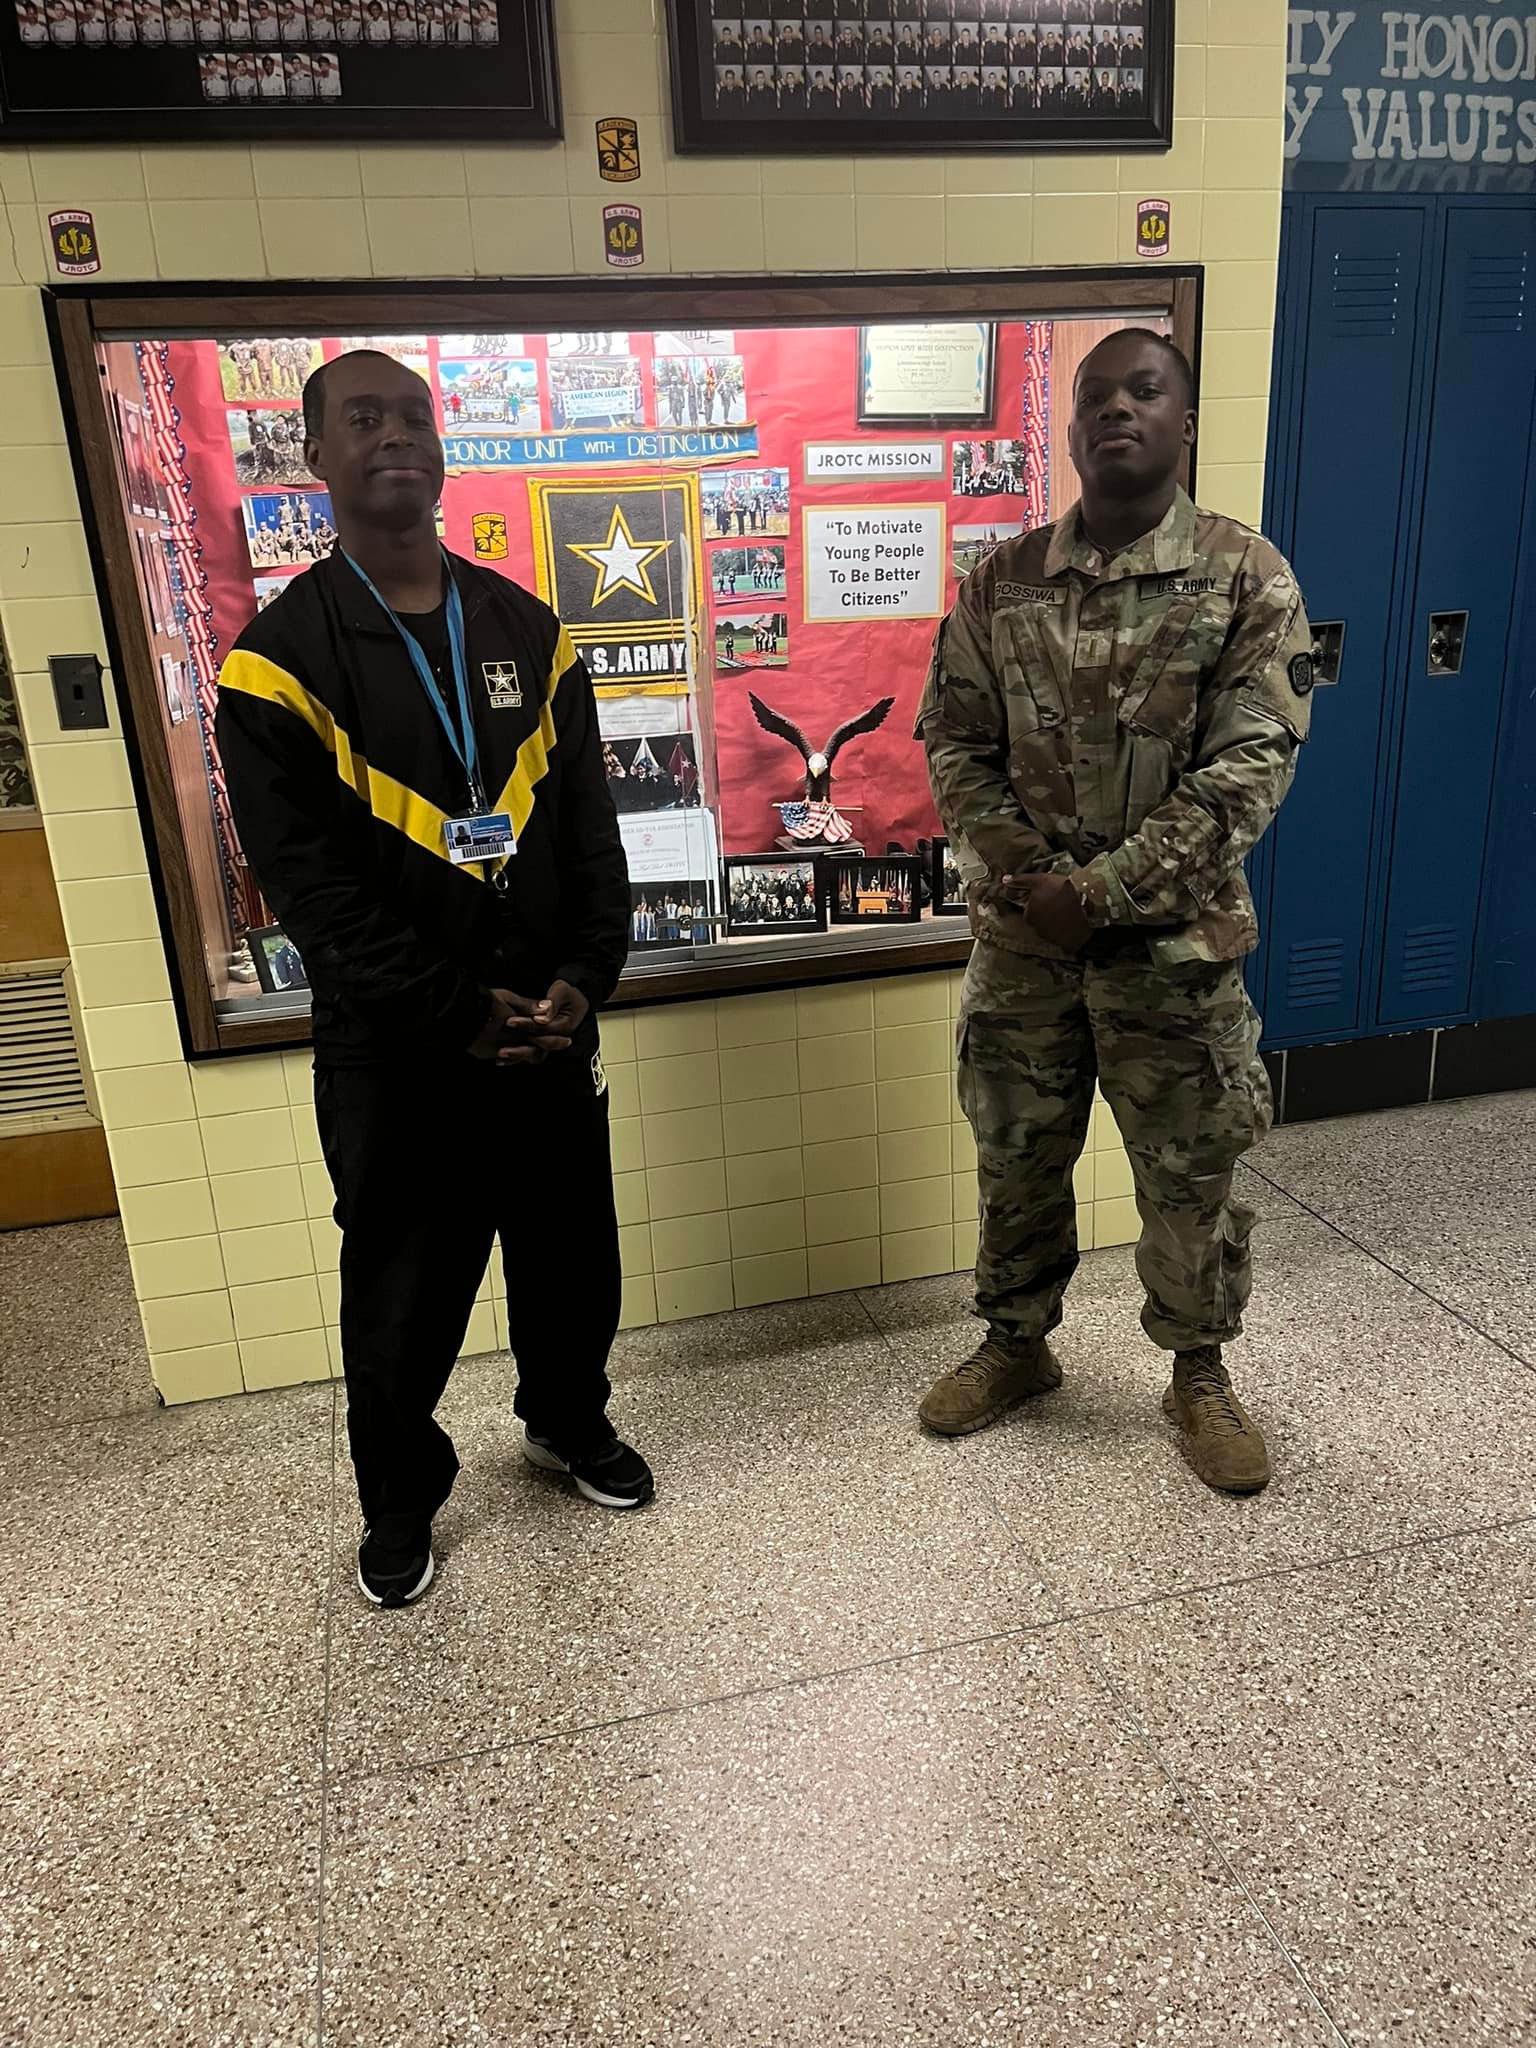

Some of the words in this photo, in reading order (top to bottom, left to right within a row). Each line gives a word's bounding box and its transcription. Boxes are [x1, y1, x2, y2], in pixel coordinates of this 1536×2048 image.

[1342, 87, 1536, 163] VALUES
[68, 214, 88, 222] ARMY
[620, 208, 638, 216] ARMY
[65, 264, 93, 272] JROTC
[613, 256, 639, 265] JROTC
[443, 440, 511, 462] HONOR
[524, 438, 568, 460] UNIT
[583, 441, 615, 454] WITH
[627, 430, 739, 457] DISTINCTION
[817, 454, 863, 468] JROTC
[867, 453, 932, 467] MISSION
[857, 520, 923, 535] Motivate
[824, 546, 870, 562] Young
[874, 544, 924, 560] People
[829, 570, 846, 583] To
[851, 569, 869, 582] Be
[874, 568, 920, 582] Better
[1157, 579, 1178, 593] U.S.
[1182, 577, 1217, 593] ARMY
